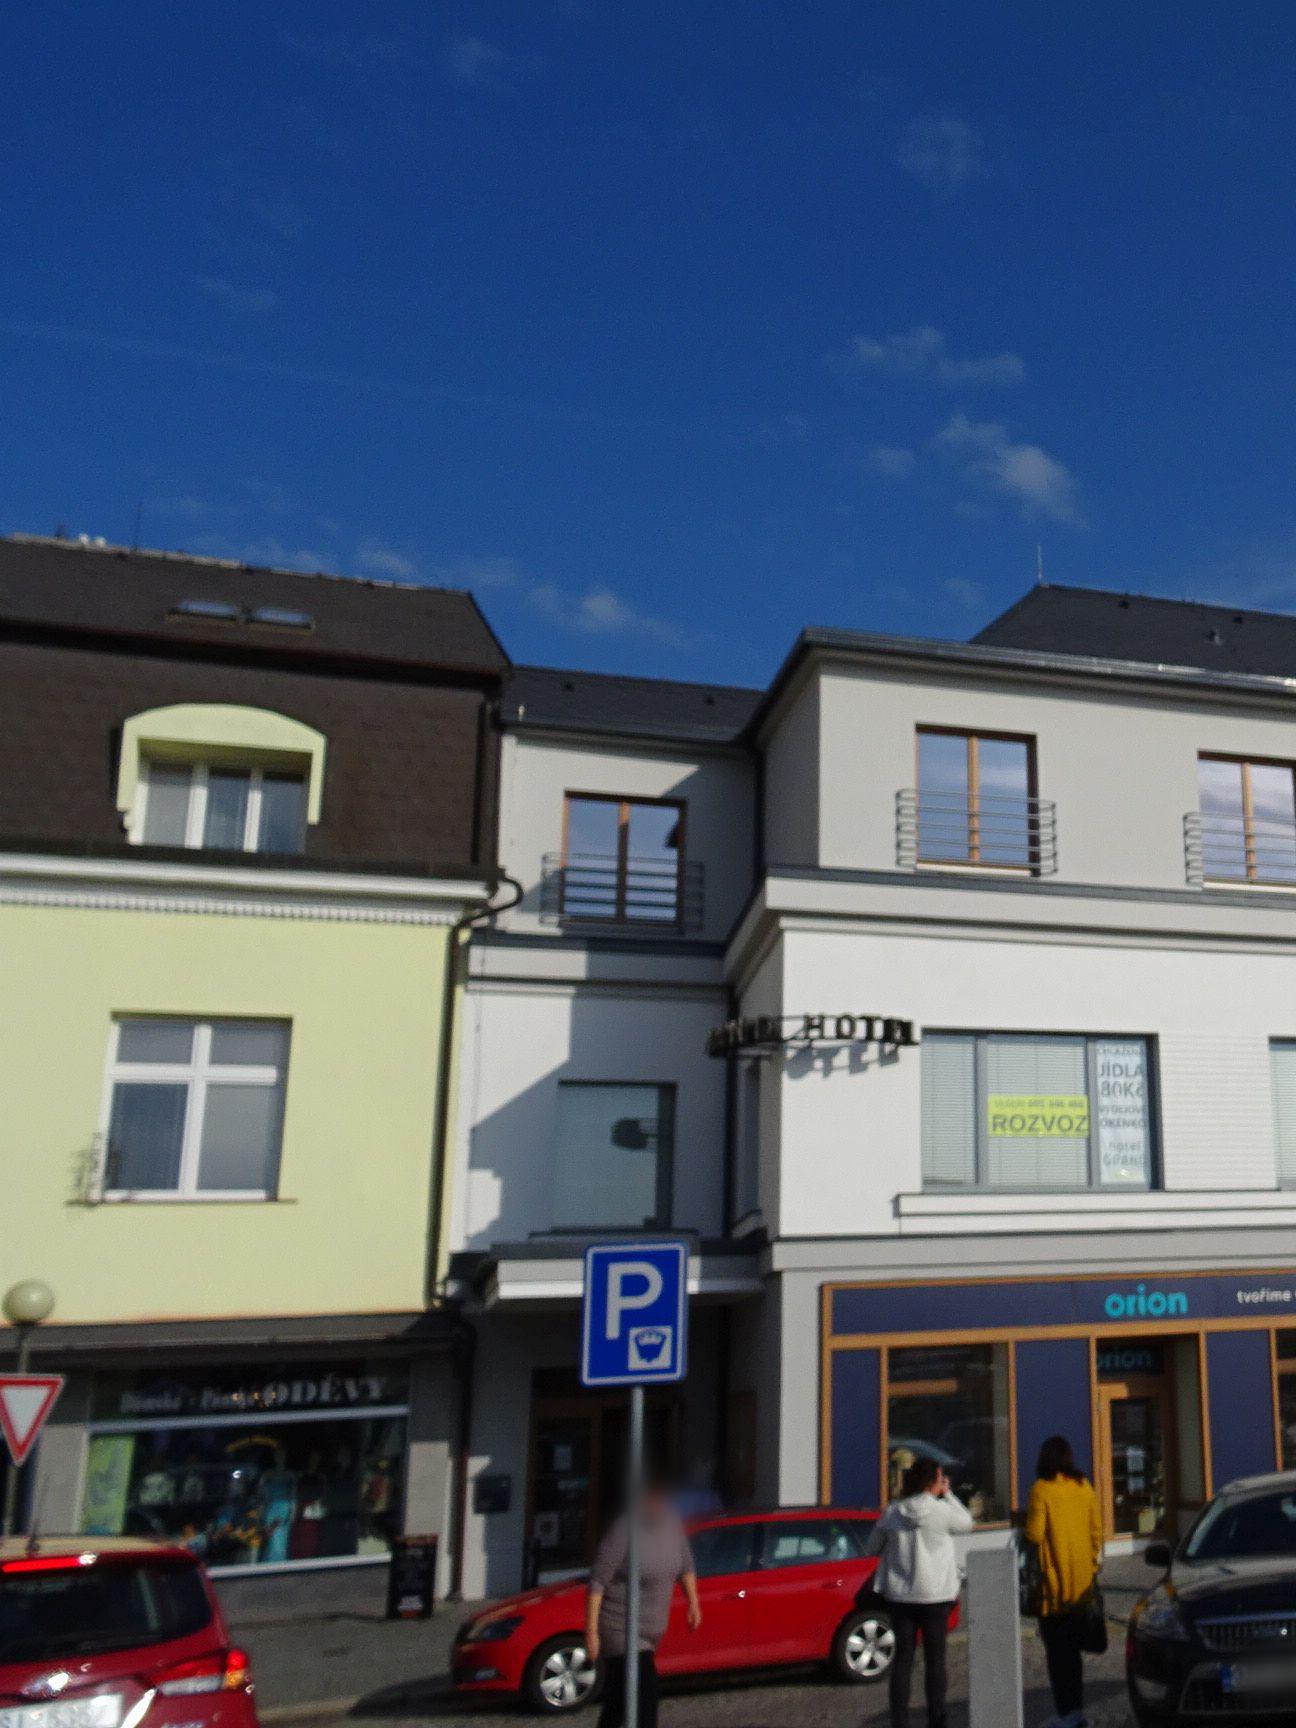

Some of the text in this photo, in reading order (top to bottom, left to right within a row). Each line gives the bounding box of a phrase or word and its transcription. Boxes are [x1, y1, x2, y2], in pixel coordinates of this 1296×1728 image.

[991, 1114, 1088, 1133] ROZVOZ
[606, 1261, 663, 1340] P
[1104, 1284, 1188, 1318] orion
[1237, 1286, 1291, 1304] tvoříme
